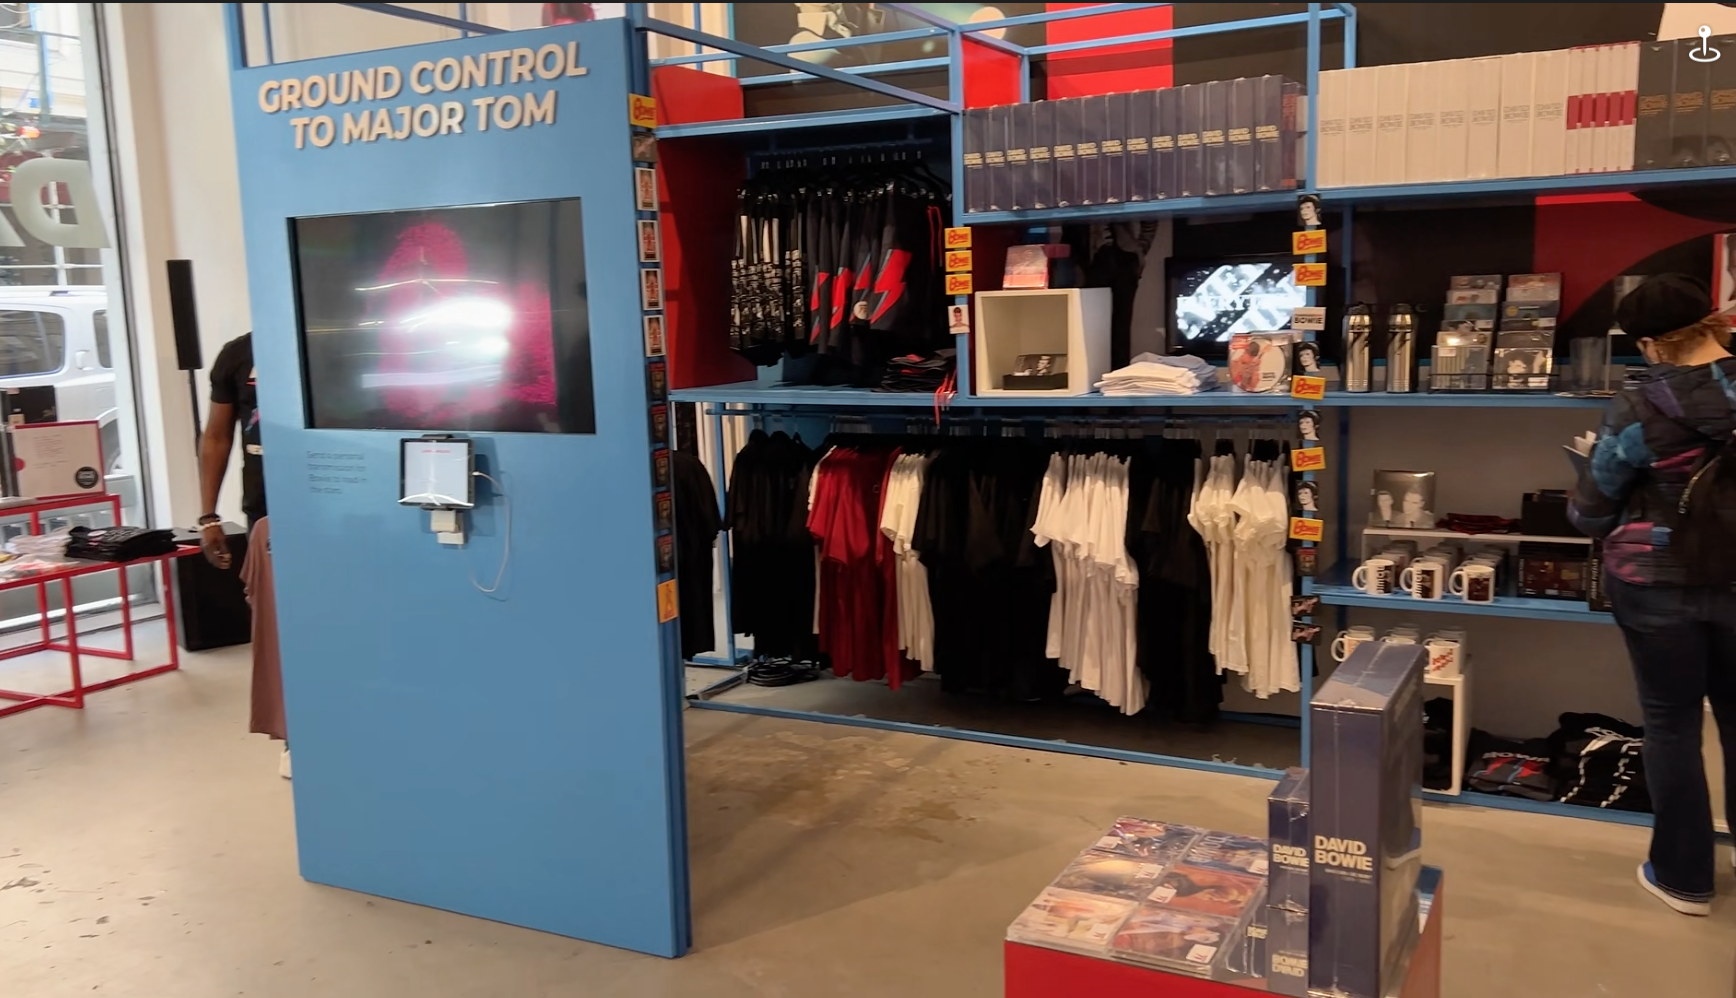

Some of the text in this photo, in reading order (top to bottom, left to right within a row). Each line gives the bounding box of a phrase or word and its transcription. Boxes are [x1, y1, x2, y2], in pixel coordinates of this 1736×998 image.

[258, 40, 588, 115] GROUND CONTROL
[290, 89, 558, 150] TO MAJOR TOM
[1294, 316, 1323, 325] BOWIE
[1272, 844, 1306, 858] DAVID
[1314, 834, 1367, 854] DAVID
[1272, 852, 1310, 868] BOWIE
[1314, 849, 1373, 871] BOWIE
